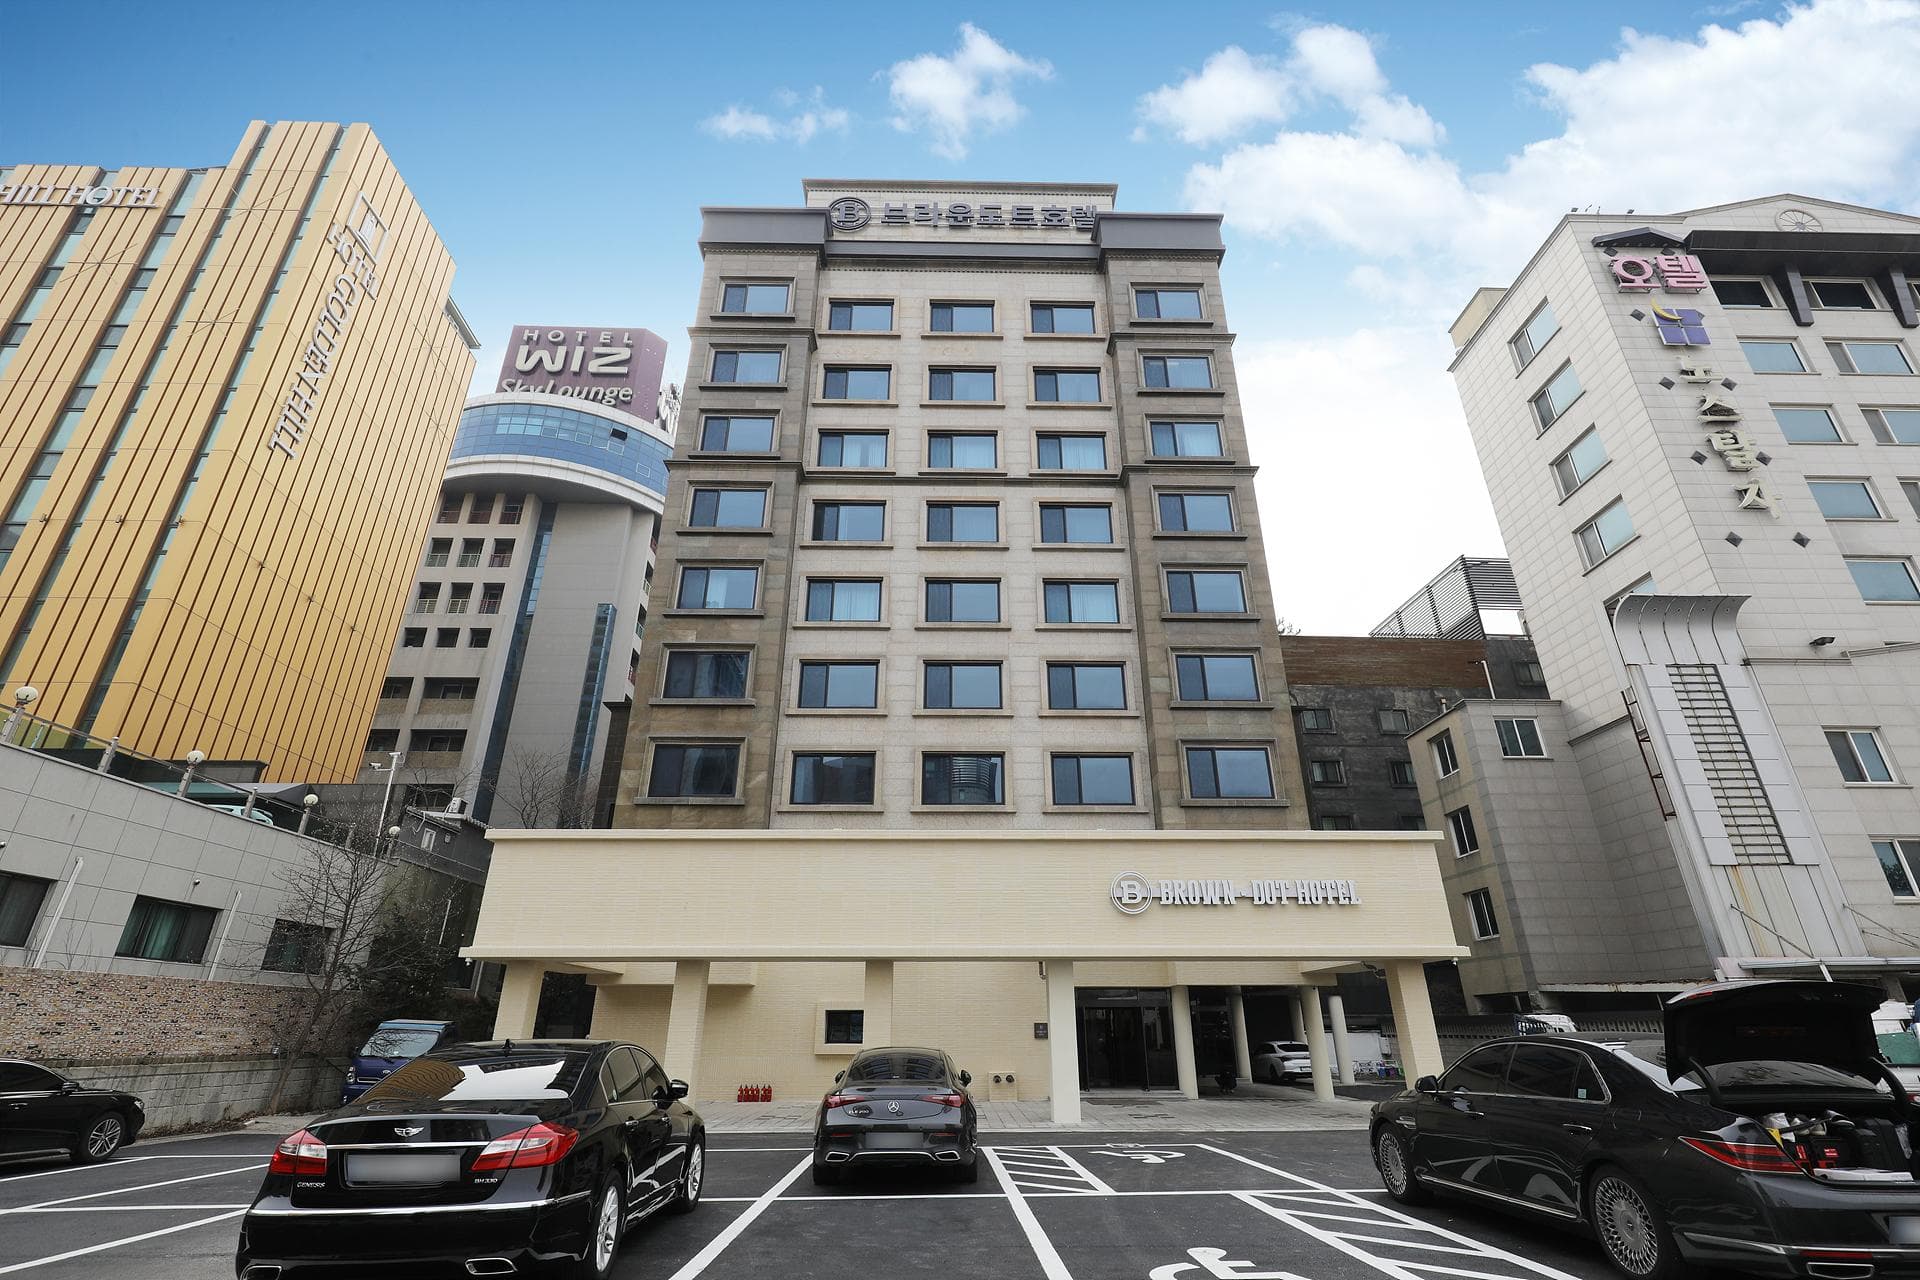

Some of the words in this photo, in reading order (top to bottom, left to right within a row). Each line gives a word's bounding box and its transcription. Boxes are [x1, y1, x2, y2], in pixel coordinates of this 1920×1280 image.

[62, 185, 160, 208] HOTEL
[327, 222, 378, 301] HOTEL
[523, 329, 633, 345] HOTEL
[515, 345, 631, 374] WIZ
[546, 379, 633, 406] Lounge
[1294, 879, 1361, 905] HOTEL
